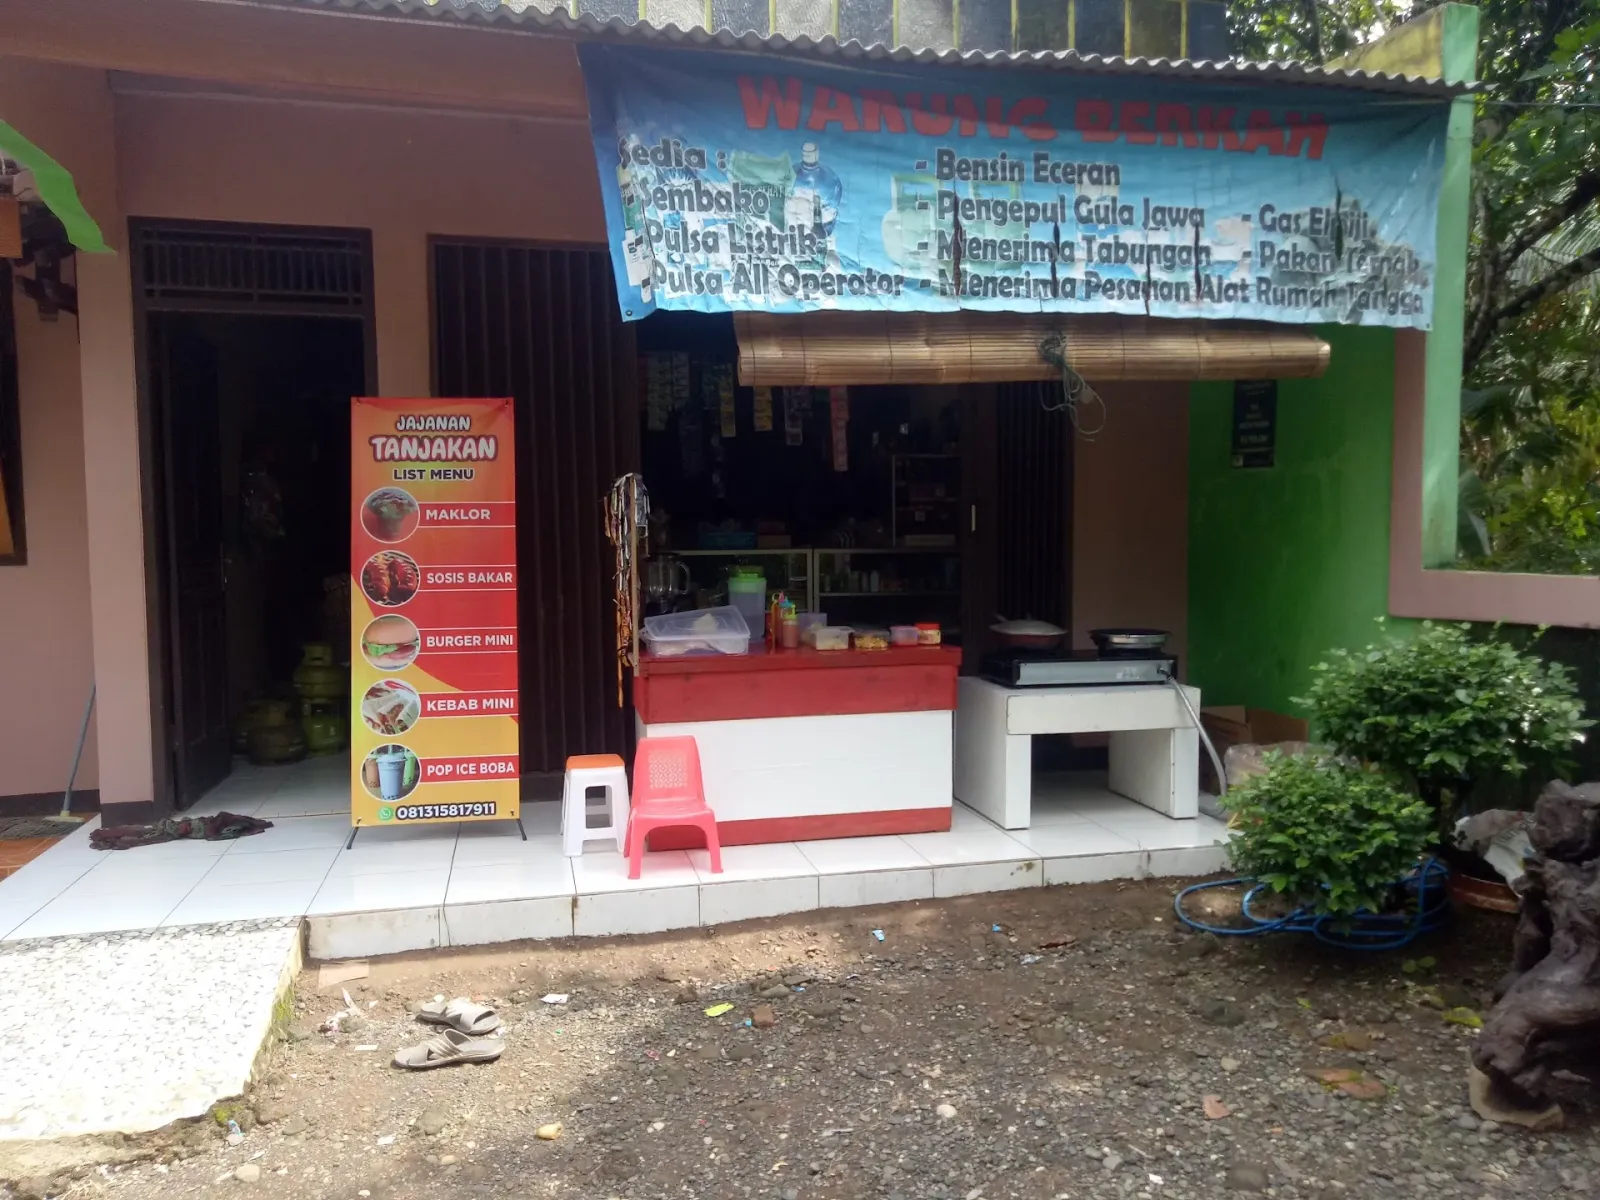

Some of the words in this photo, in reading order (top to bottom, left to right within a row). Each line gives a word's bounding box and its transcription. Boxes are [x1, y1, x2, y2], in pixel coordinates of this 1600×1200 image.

[737, 75, 1058, 140] WARUNG
[1075, 98, 1330, 160] BERKAH
[617, 136, 707, 170] Sedia
[936, 148, 1025, 182] Bensin
[1033, 151, 1120, 185] Eceran
[640, 177, 770, 215] Sembako
[937, 189, 1066, 228] Pengepul
[1074, 194, 1134, 225] Gula
[1142, 197, 1205, 230] Jawa
[1258, 204, 1302, 233] Gas
[645, 218, 720, 254] Pulsa
[728, 221, 818, 256] Listrik
[1082, 234, 1212, 268] Tabungan
[1259, 240, 1337, 272] Pakan
[650, 257, 724, 295] Pulsa
[733, 263, 770, 295] All
[778, 263, 903, 300] Operator
[1084, 270, 1190, 301] Pesanan
[1200, 274, 1250, 303] Alat
[1256, 276, 1337, 309] Rumah
[397, 415, 471, 431] JAJANAN
[371, 436, 497, 461] TANJAKAN
[393, 469, 426, 480] LIST
[430, 469, 474, 480] MENU
[425, 509, 491, 520] MAKLOR
[426, 572, 465, 584] SOSIS
[468, 572, 513, 583] BAKAR
[426, 635, 482, 647] BURGER
[485, 634, 513, 646] MINI
[427, 699, 478, 712] KEBAB
[482, 698, 514, 710] MINI
[427, 764, 453, 776] POP
[456, 763, 475, 774] ICE
[479, 761, 515, 774] BOBA
[396, 803, 496, 819] 081315817911
